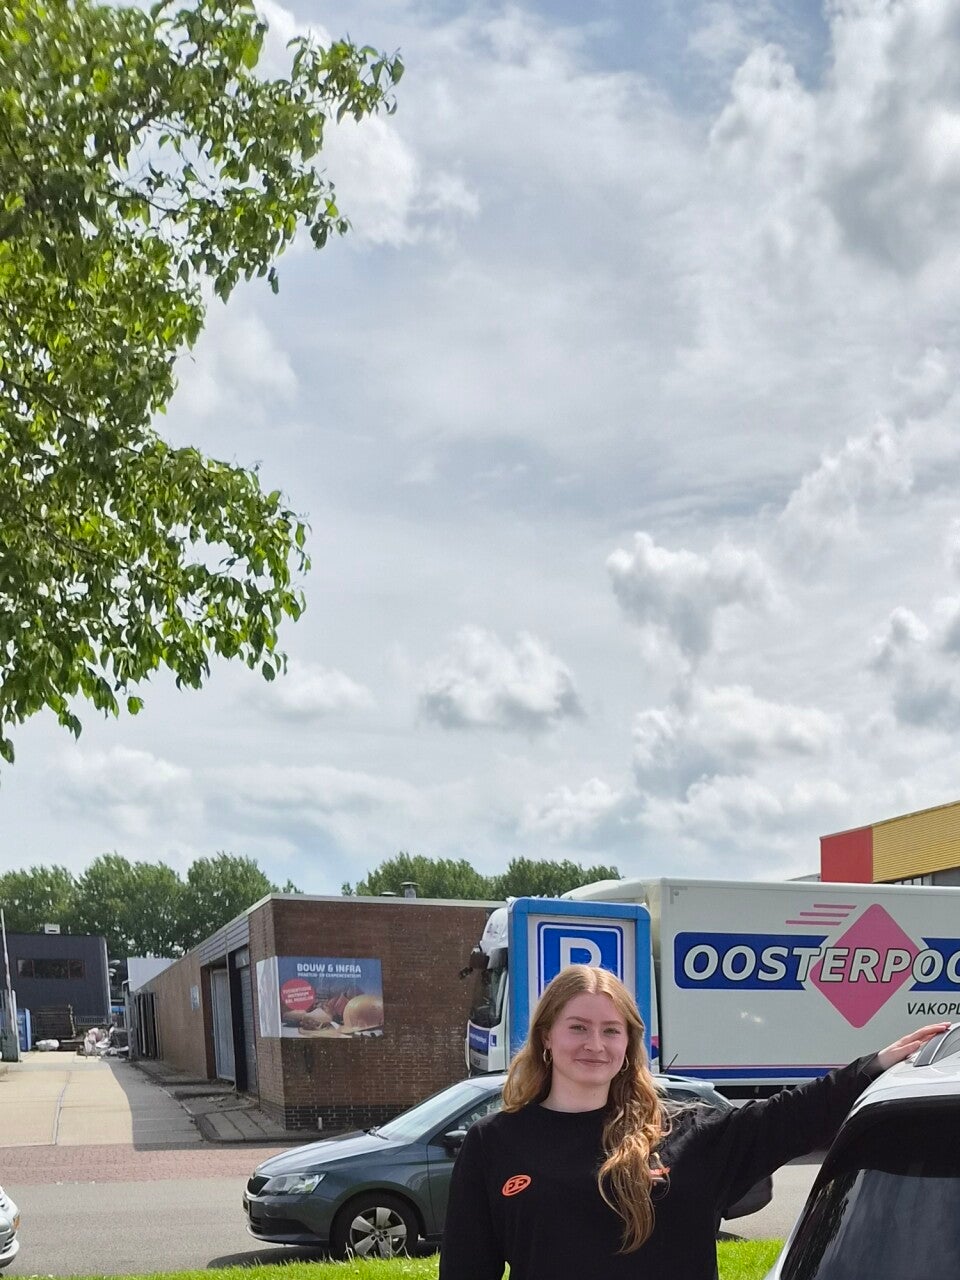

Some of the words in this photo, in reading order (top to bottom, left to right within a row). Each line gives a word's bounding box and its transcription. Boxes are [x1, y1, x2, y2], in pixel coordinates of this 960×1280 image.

[296, 963, 326, 973] BOUW
[327, 964, 334, 973] &
[335, 964, 361, 973] INFRA
